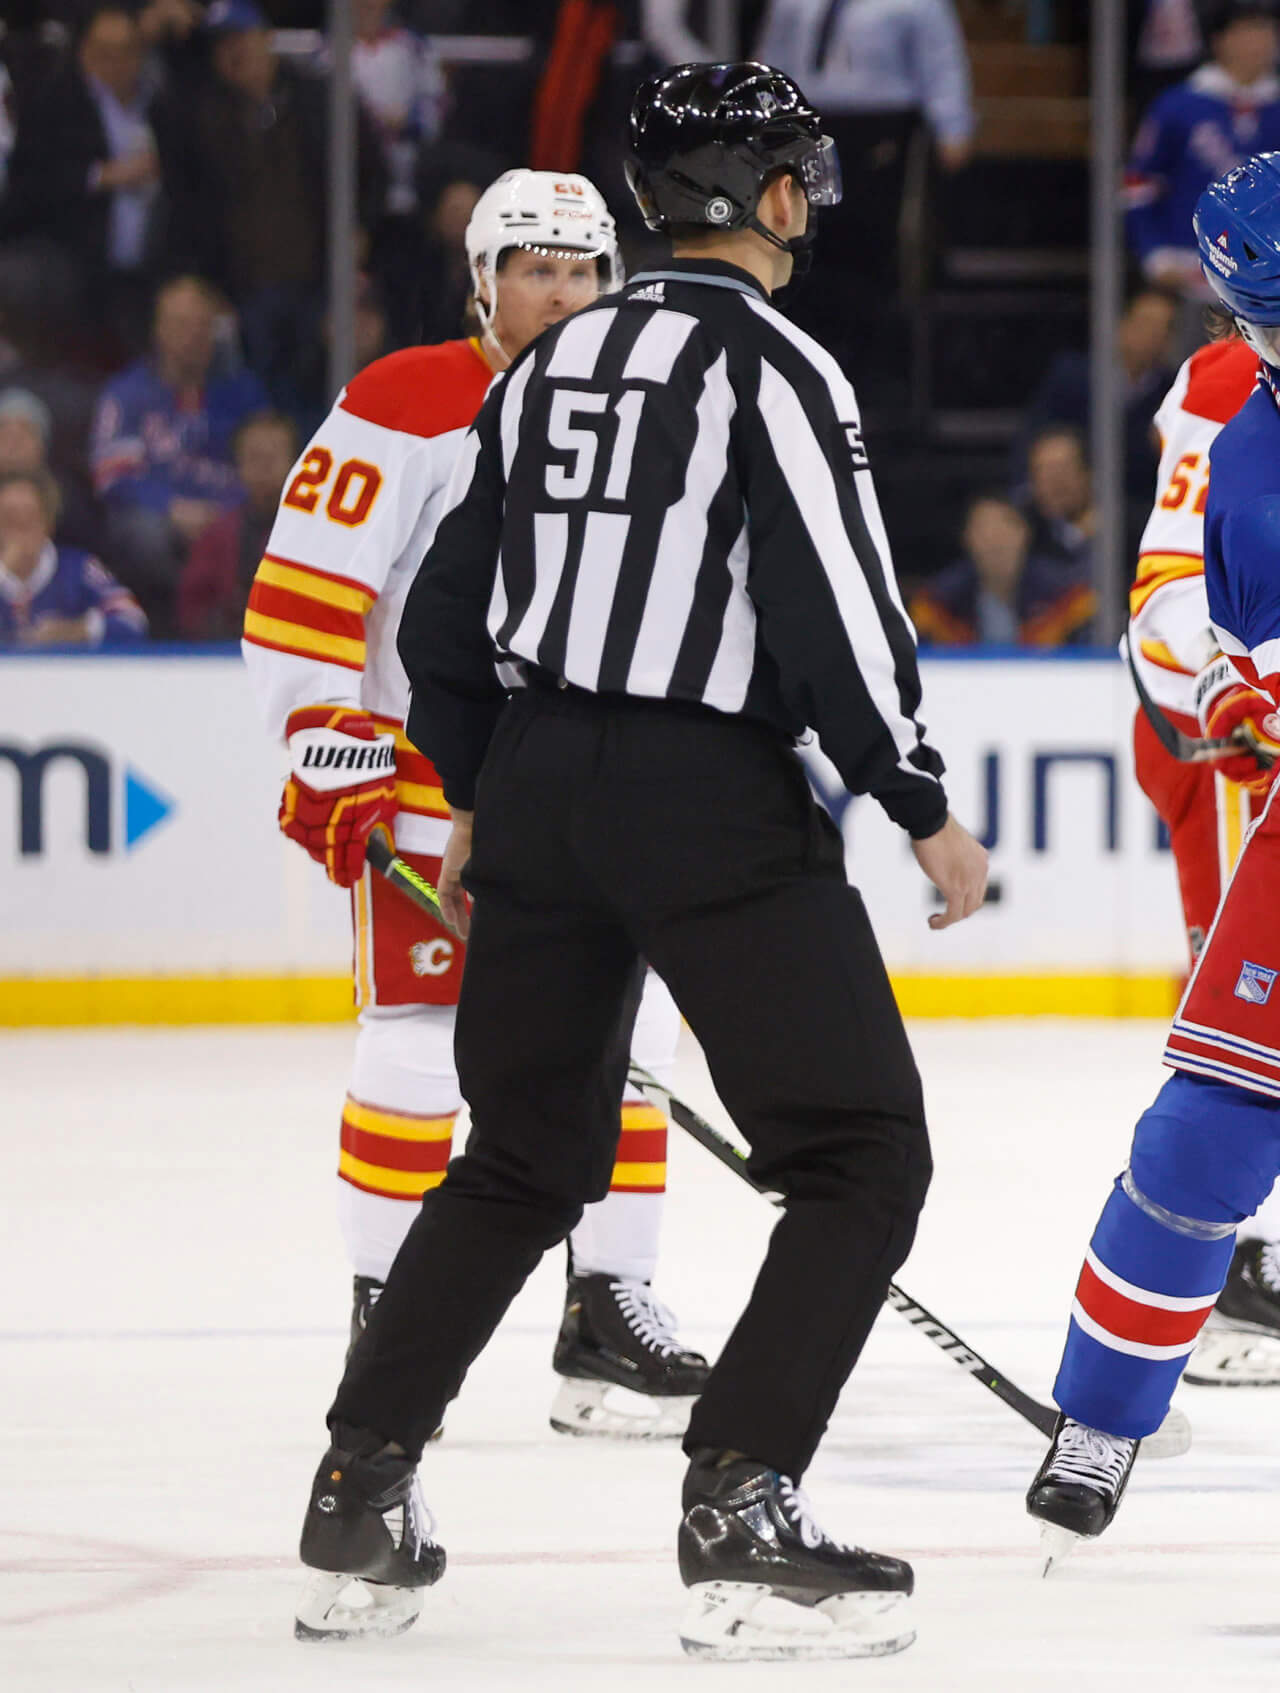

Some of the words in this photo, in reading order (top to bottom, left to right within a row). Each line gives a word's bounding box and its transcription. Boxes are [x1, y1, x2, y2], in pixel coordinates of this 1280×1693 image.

[544, 389, 646, 501] 51
[843, 426, 869, 465] 5
[282, 446, 384, 529] 20
